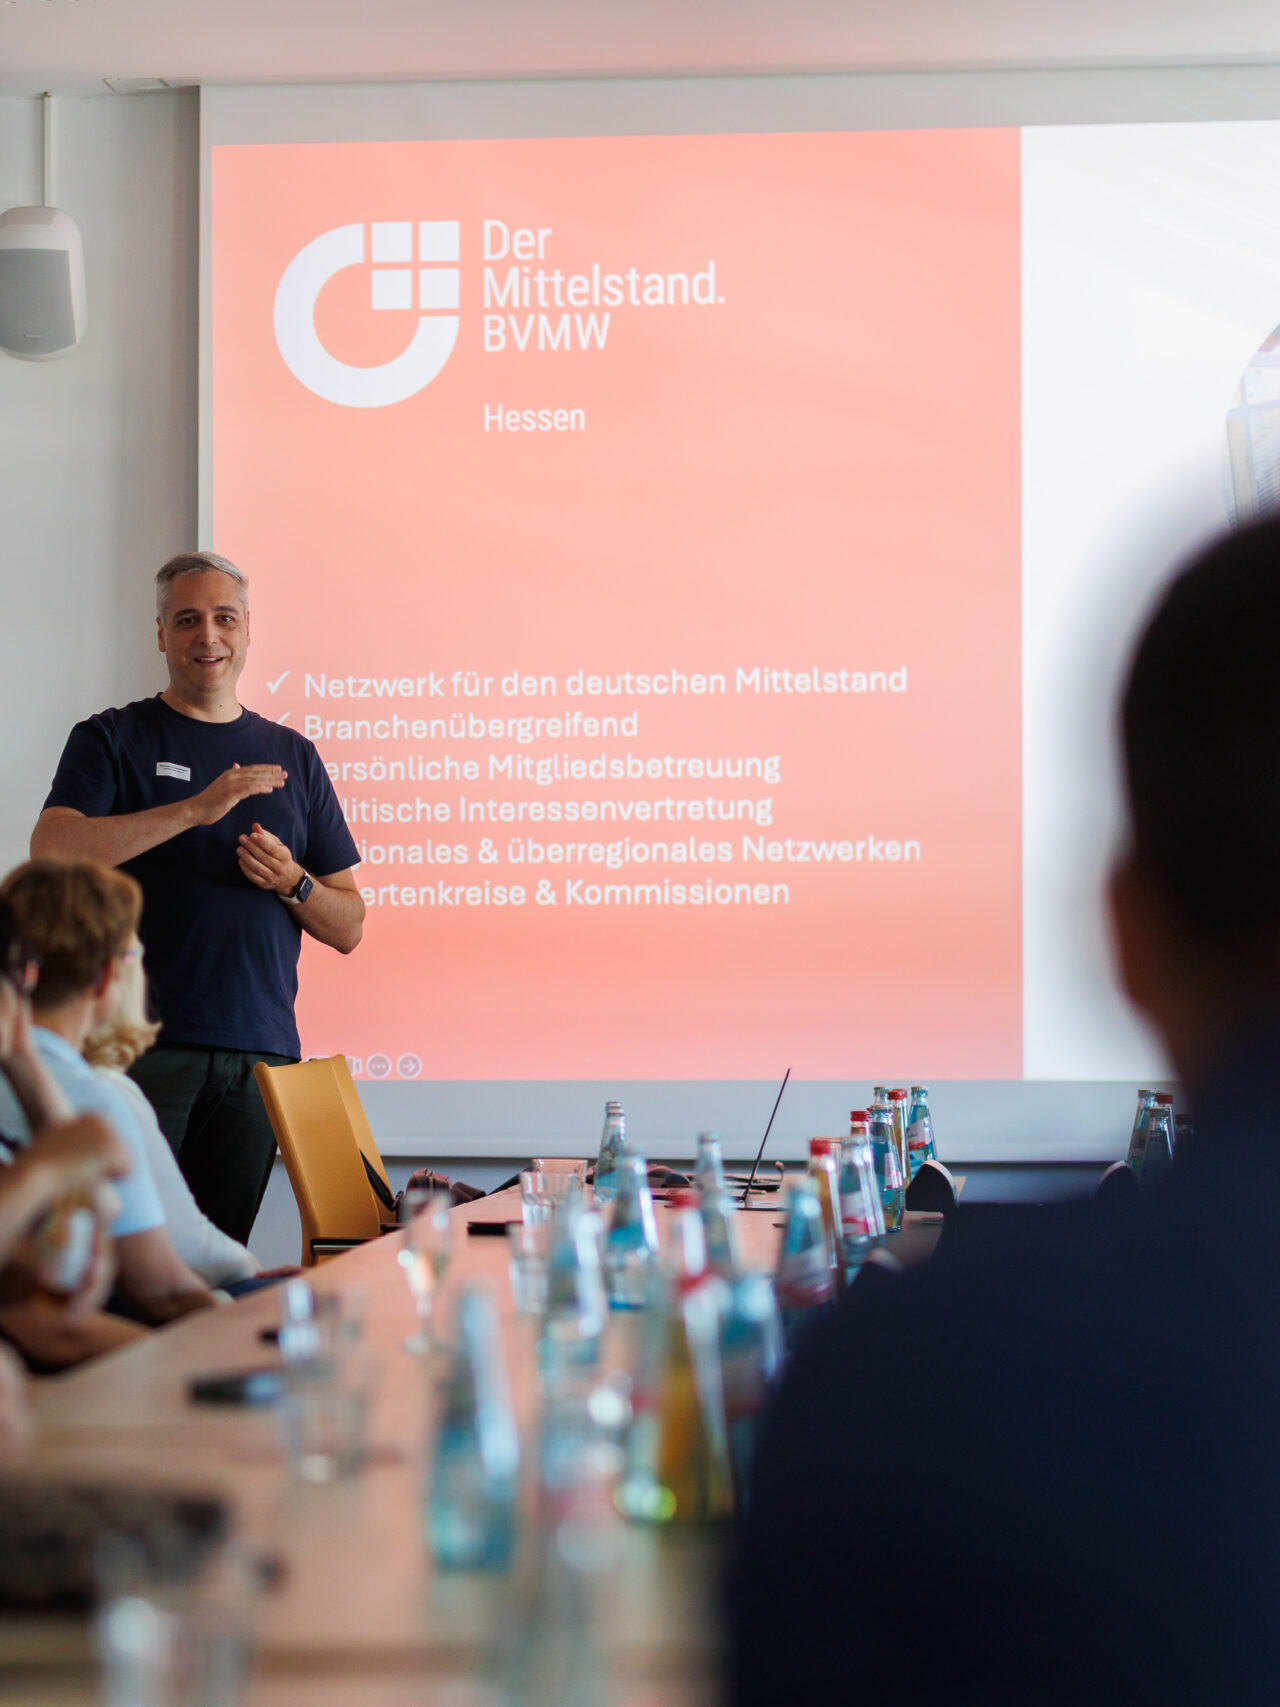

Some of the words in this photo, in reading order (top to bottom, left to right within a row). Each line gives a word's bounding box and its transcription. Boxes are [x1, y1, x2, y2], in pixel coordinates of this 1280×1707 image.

[483, 219, 552, 260] Der
[483, 260, 726, 308] Mittelstand.
[483, 313, 611, 352] BVMW
[483, 404, 586, 432] Hessen
[304, 672, 445, 699] Netzwerk
[451, 671, 494, 697] für
[501, 669, 557, 696] den
[565, 667, 727, 696] deutschen
[735, 665, 908, 694] Mittelstand
[304, 711, 639, 744] Branchenübergreifend
[325, 754, 479, 782] ersönliche
[488, 753, 782, 785] Mitgliedsbetreuung
[343, 796, 451, 823] litische
[459, 795, 774, 827] Interessenvertretung
[477, 838, 500, 865] &
[507, 836, 734, 869] überregionales
[742, 834, 921, 863] Netzwerken
[360, 879, 527, 907] ertenkreise
[535, 878, 558, 907] &
[565, 877, 790, 906] Kommissionen
